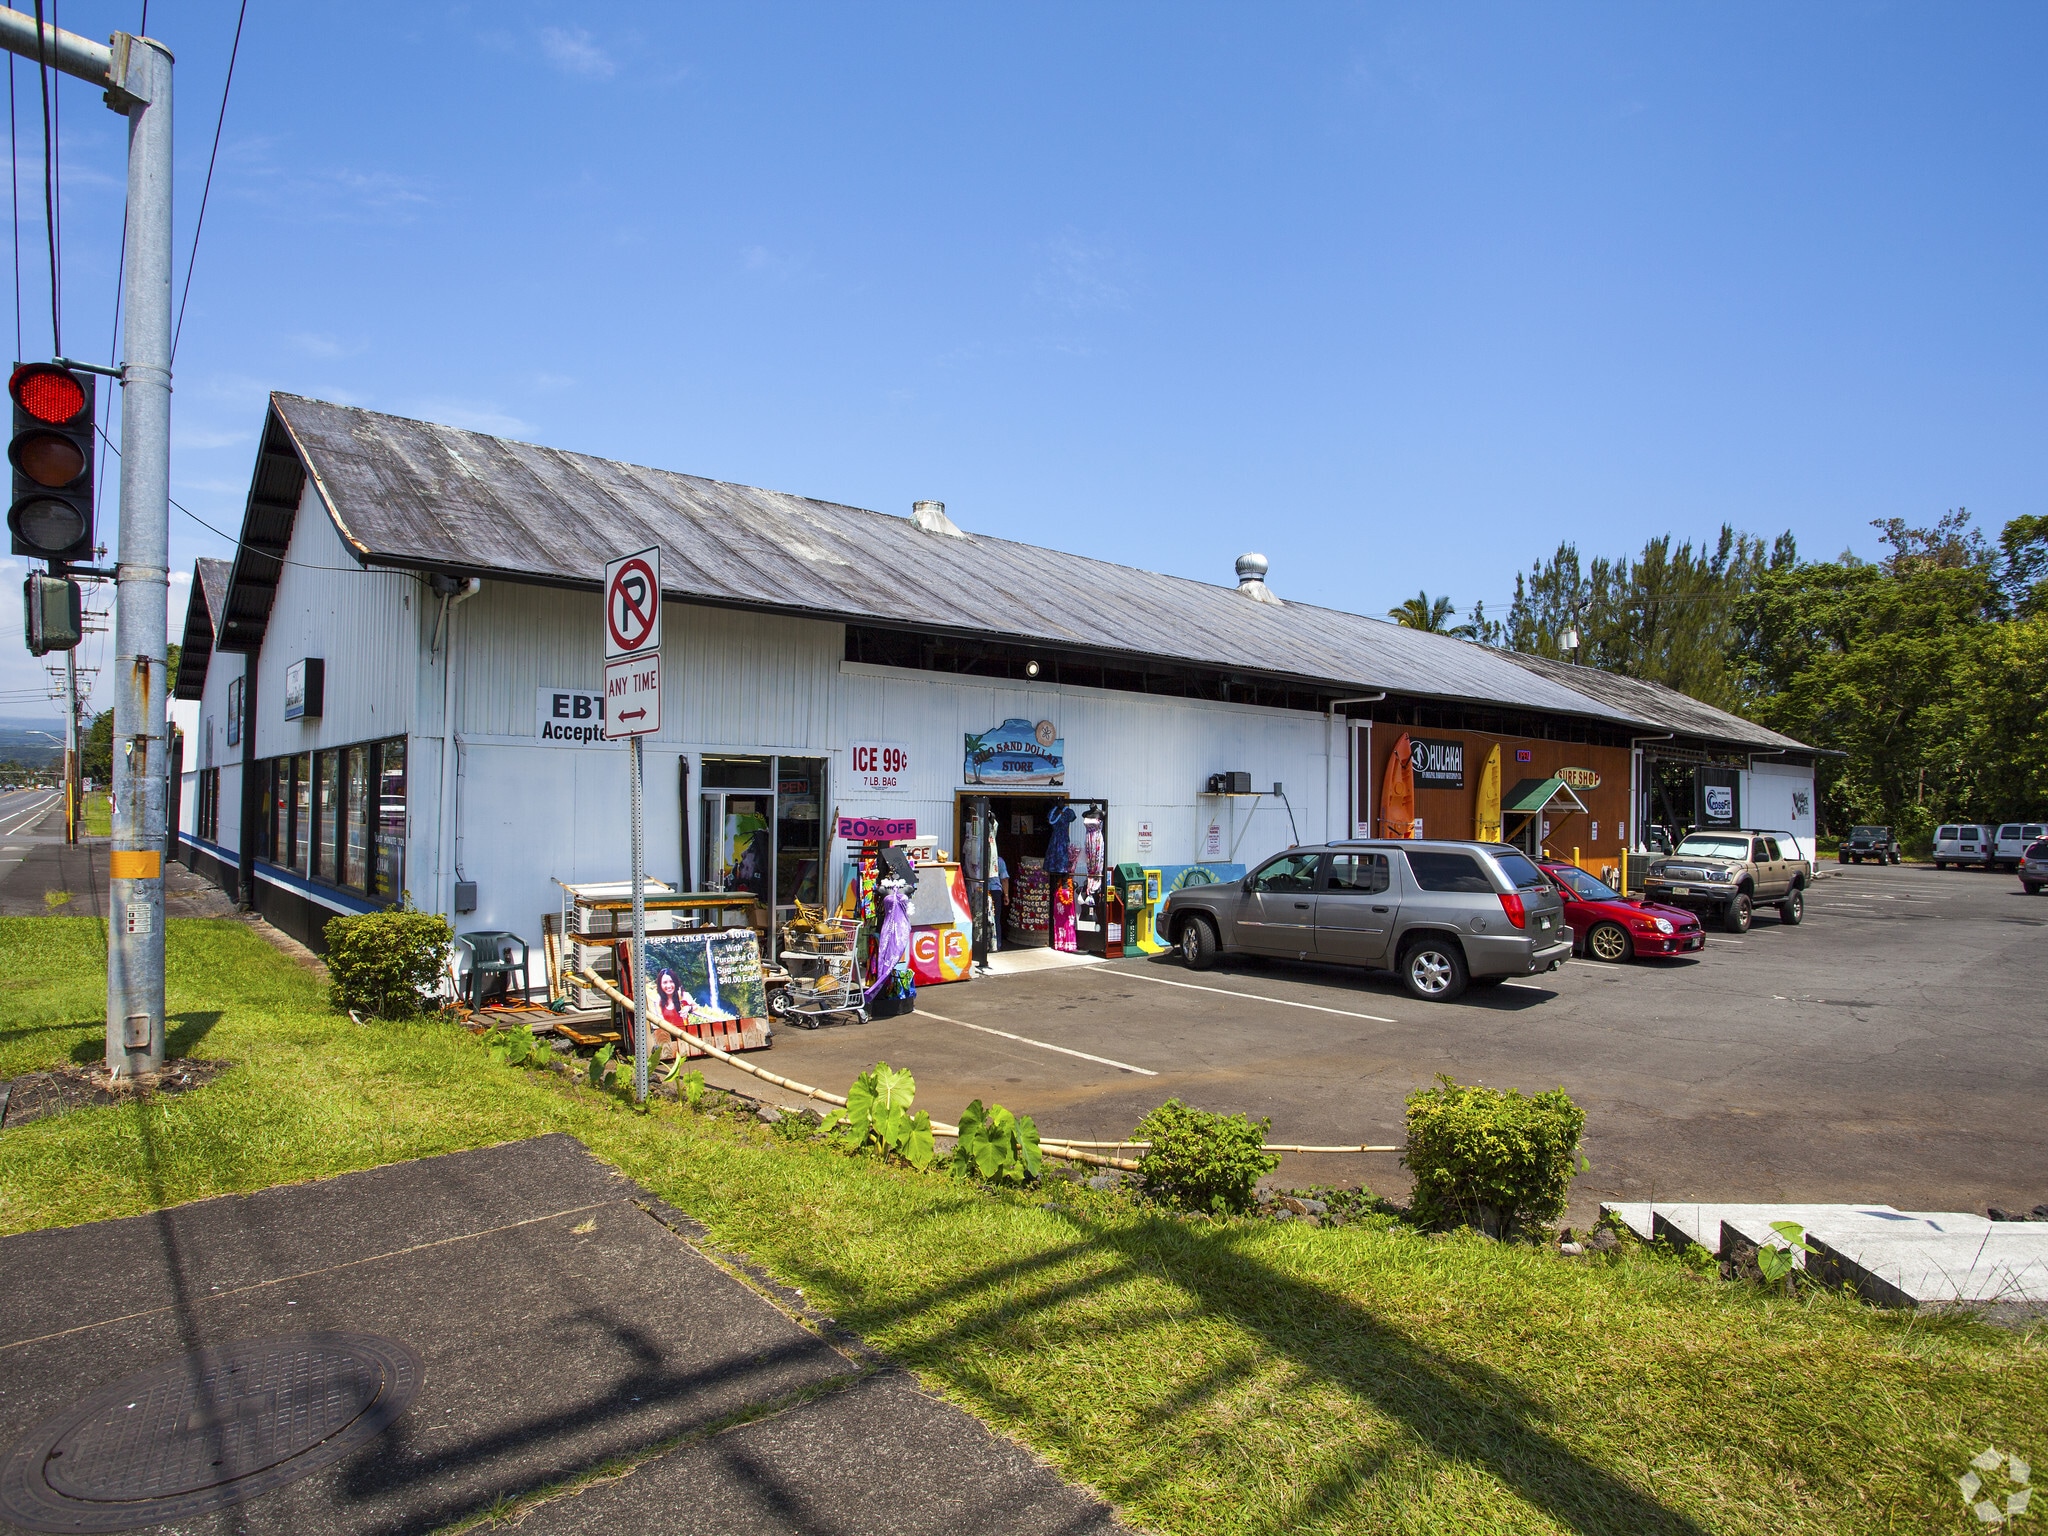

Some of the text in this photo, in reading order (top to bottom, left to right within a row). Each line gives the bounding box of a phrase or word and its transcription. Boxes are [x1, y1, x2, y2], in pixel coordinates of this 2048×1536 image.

[608, 670, 657, 698] ANY TIME
[542, 721, 617, 745] Accepte
[853, 746, 878, 772] ICE
[996, 741, 1022, 754] SAND
[1024, 742, 1059, 768] DOLLAR
[1430, 744, 1463, 772] HULAKAI
[1002, 760, 1034, 772] STORE
[863, 777, 897, 787] 7 LB. BAG
[1558, 769, 1600, 786] SURF SHOP
[779, 781, 808, 793] PEN
[840, 820, 914, 837] 20% OFF
[645, 936, 667, 945] Free
[704, 933, 728, 942] Falls
[731, 930, 750, 939] Tour
[726, 944, 743, 952] With
[715, 952, 757, 964] Purchase Of
[717, 964, 756, 974] Sugar Cane
[719, 973, 760, 985] $40.00 Each
